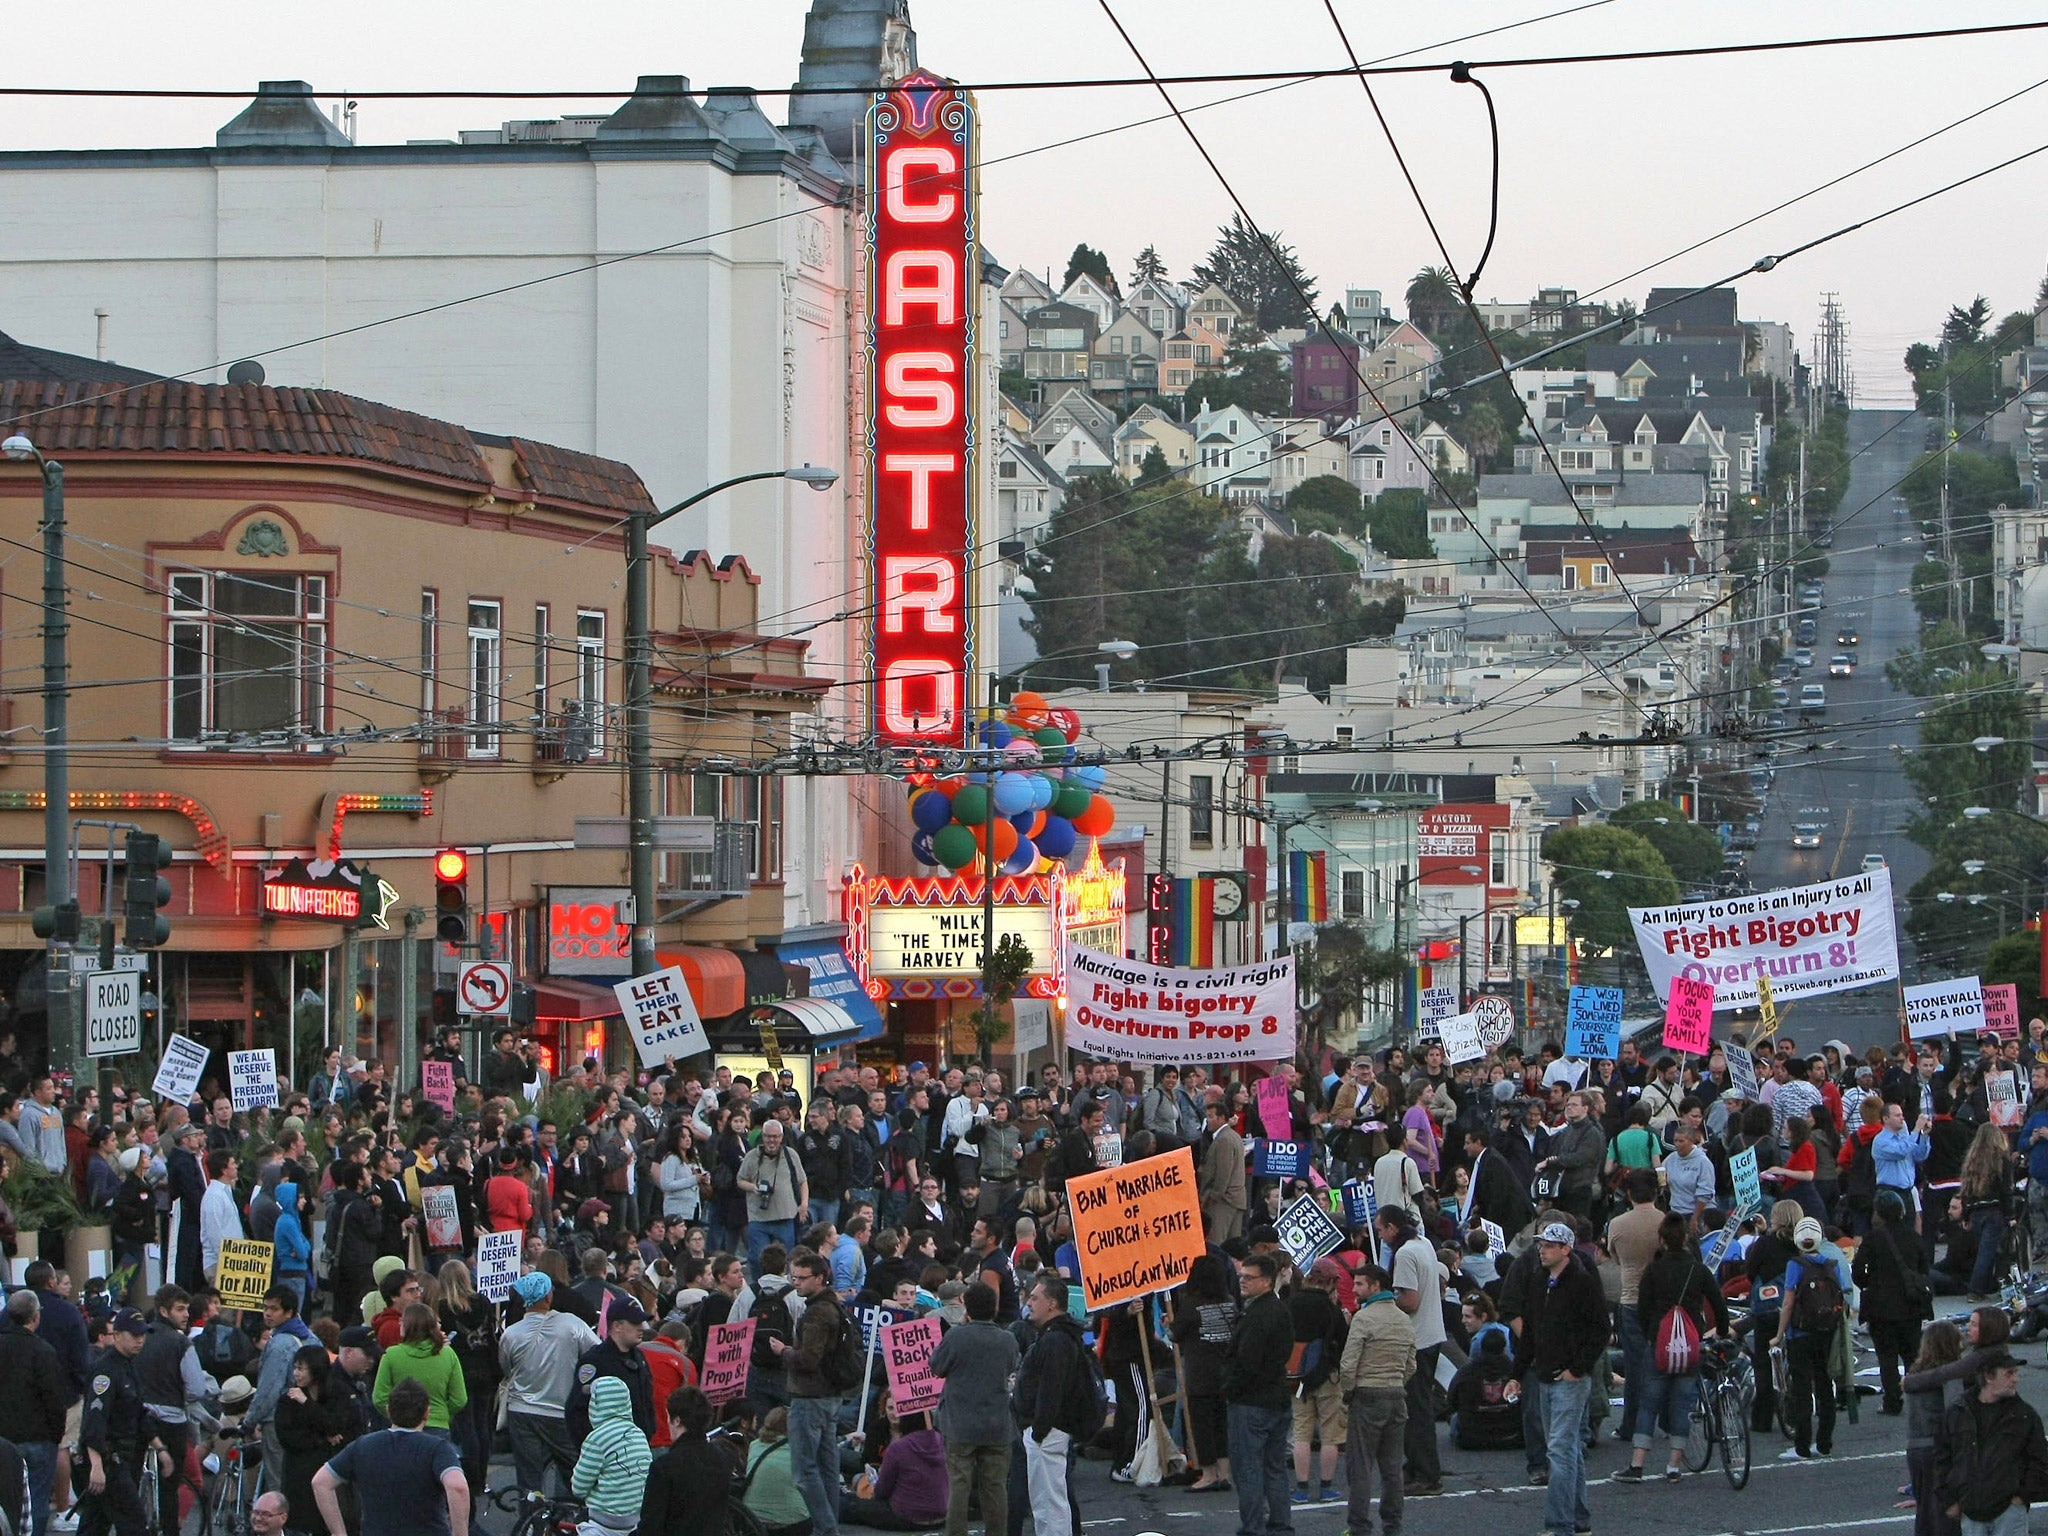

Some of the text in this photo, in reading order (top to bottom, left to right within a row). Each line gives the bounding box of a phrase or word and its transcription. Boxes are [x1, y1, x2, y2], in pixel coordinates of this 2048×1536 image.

[884, 147, 955, 738] CASTRO
[1432, 814, 1472, 823] FACTORY
[1443, 824, 1483, 833] PIZZERIA
[264, 884, 360, 917] TWIN PEAKS
[1642, 877, 1872, 926] An Injury to One is an Injury to All
[894, 933, 929, 948] "THE
[1663, 908, 1861, 960] Fight Bigotry
[121, 958, 134, 968] ST
[902, 952, 964, 968] HARVEY
[1682, 940, 1857, 985] Overturn 8!
[1073, 952, 1289, 989] Marriage is a civil right
[98, 983, 130, 1008] ROAD
[631, 976, 670, 1000] LET
[1424, 988, 1451, 998] WE ALL
[1577, 986, 1618, 1000] I WISH
[1678, 979, 1710, 1000] FOCUS
[1981, 988, 2009, 1000] Down
[636, 993, 679, 1012] THEM
[1092, 983, 1257, 1018] Fight bigotry
[1421, 996, 1455, 1008] DESERVE
[1571, 999, 1620, 1012] I LIVED
[1685, 998, 1696, 1007] ON
[1907, 990, 1981, 1011] STONEWALL
[1984, 1000, 2006, 1012] with
[639, 1005, 682, 1030] EAT
[1432, 1007, 1445, 1015] THE
[1574, 1010, 1620, 1023] SOMEWHERE
[1677, 1005, 1702, 1022] YOUR
[1908, 1004, 1982, 1024] WAS A RIOT
[90, 1016, 137, 1042] CLOSED
[1076, 1006, 1278, 1043] Overturn Prop 8
[1478, 1016, 1511, 1032] ISHOP
[1680, 1020, 1696, 1029] OWN
[1986, 1014, 2014, 1027] rop 8!
[644, 1023, 695, 1045] CAKE!
[1421, 1028, 1431, 1036] TO
[1581, 1034, 1604, 1044] LIKE
[1666, 1024, 1706, 1048] FAMILY
[236, 1052, 267, 1063] WE ALL
[1083, 1040, 1256, 1062] Equal Rights Initiative 415-821-6144
[233, 1063, 271, 1074] DESERVE
[245, 1075, 261, 1084] THE
[234, 1084, 274, 1096] FREEDOM
[234, 1096, 277, 1108] TO MARRY
[1268, 1142, 1297, 1154] I DO
[1076, 1166, 1182, 1214] BAN MARRIAGE
[1351, 1187, 1355, 1199] I
[1124, 1205, 1140, 1219] OF
[1281, 1201, 1311, 1231] TO VOTE
[1299, 1208, 1319, 1227] ON
[1087, 1224, 1140, 1255] CHURCH
[1153, 1210, 1190, 1237] STATE
[1305, 1217, 1326, 1236] THE
[1314, 1226, 1332, 1243] BAN
[222, 1240, 271, 1258] Marriage
[486, 1234, 514, 1248] WE ALL
[482, 1246, 517, 1261] DESERVE
[223, 1257, 267, 1274] Equality
[491, 1261, 506, 1272] THE
[220, 1274, 266, 1295] for All!
[480, 1272, 518, 1287] FREEDOM
[717, 1326, 748, 1345] Down
[892, 1323, 932, 1347] Fight
[718, 1343, 742, 1363] with
[706, 1362, 745, 1386] Prop 8!
[910, 1385, 933, 1397] Now
